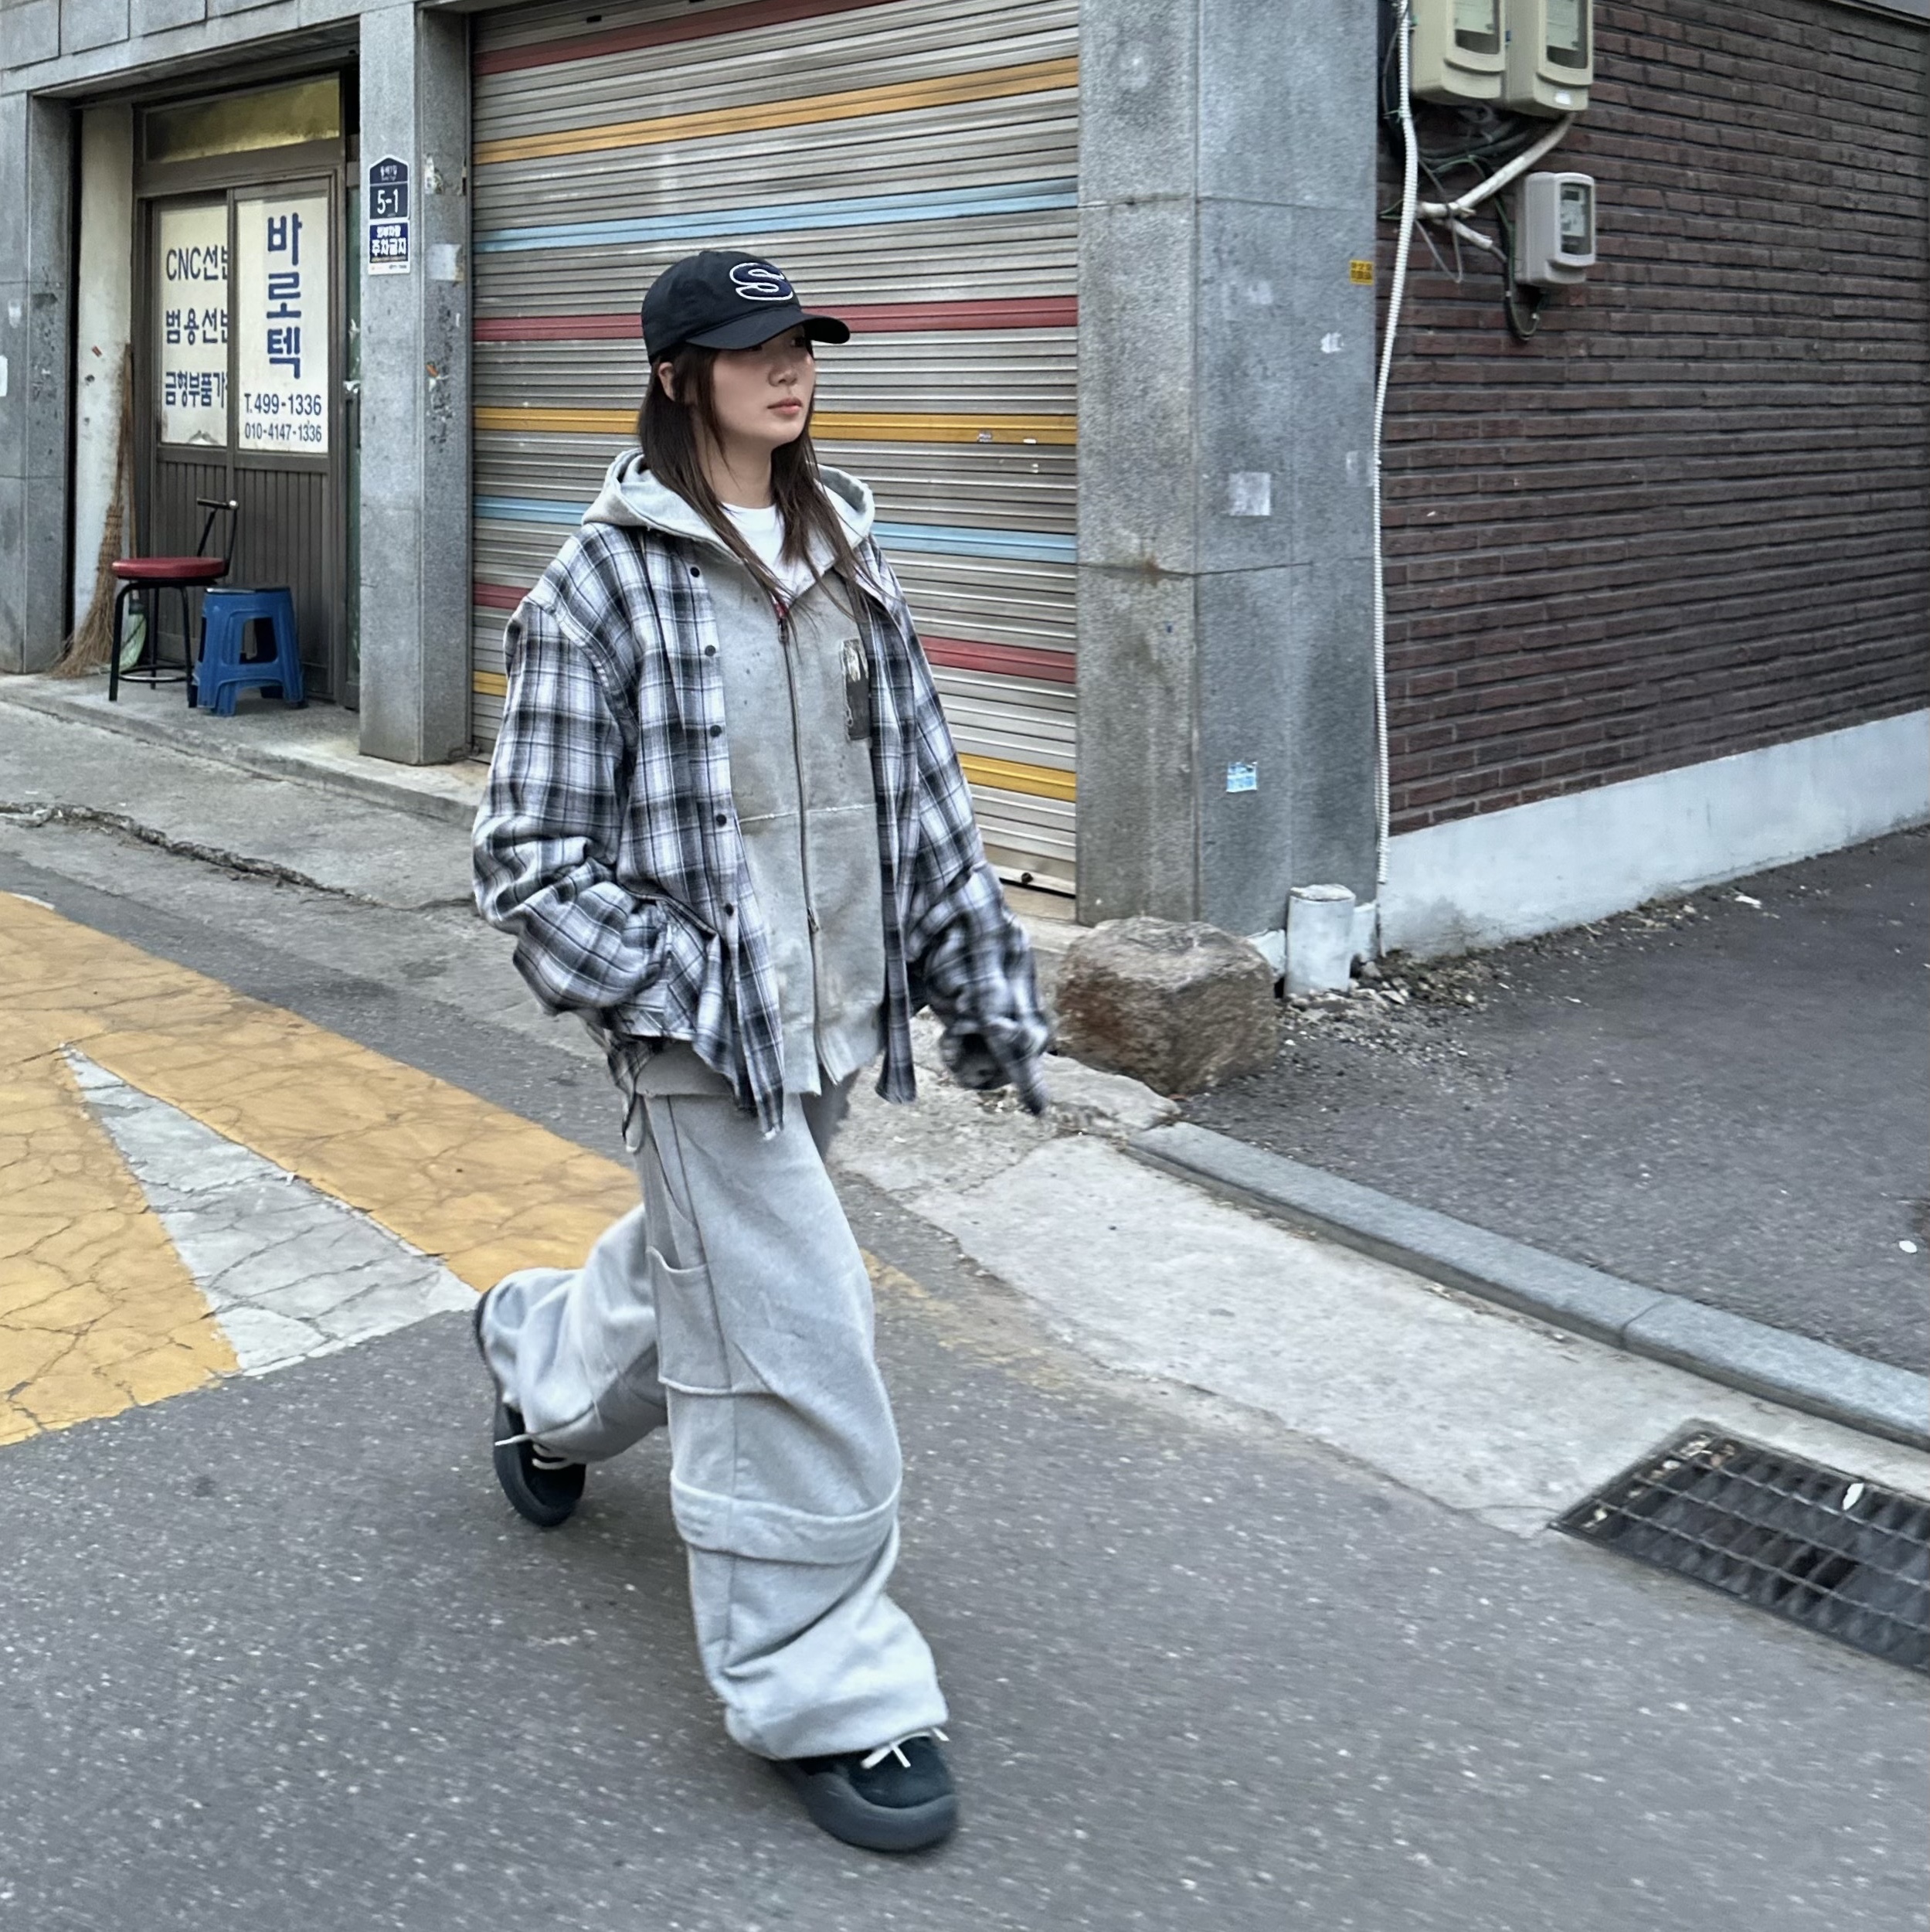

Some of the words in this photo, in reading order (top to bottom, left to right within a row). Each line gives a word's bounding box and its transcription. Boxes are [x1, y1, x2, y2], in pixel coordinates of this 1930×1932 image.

[377, 188, 399, 214] 5-1
[372, 237, 406, 257] 주차금지
[267, 212, 303, 379] 바로텍
[165, 370, 228, 409] 금형부품가
[244, 393, 321, 416] T.499-1336
[244, 421, 322, 442] 010-4147-1336
